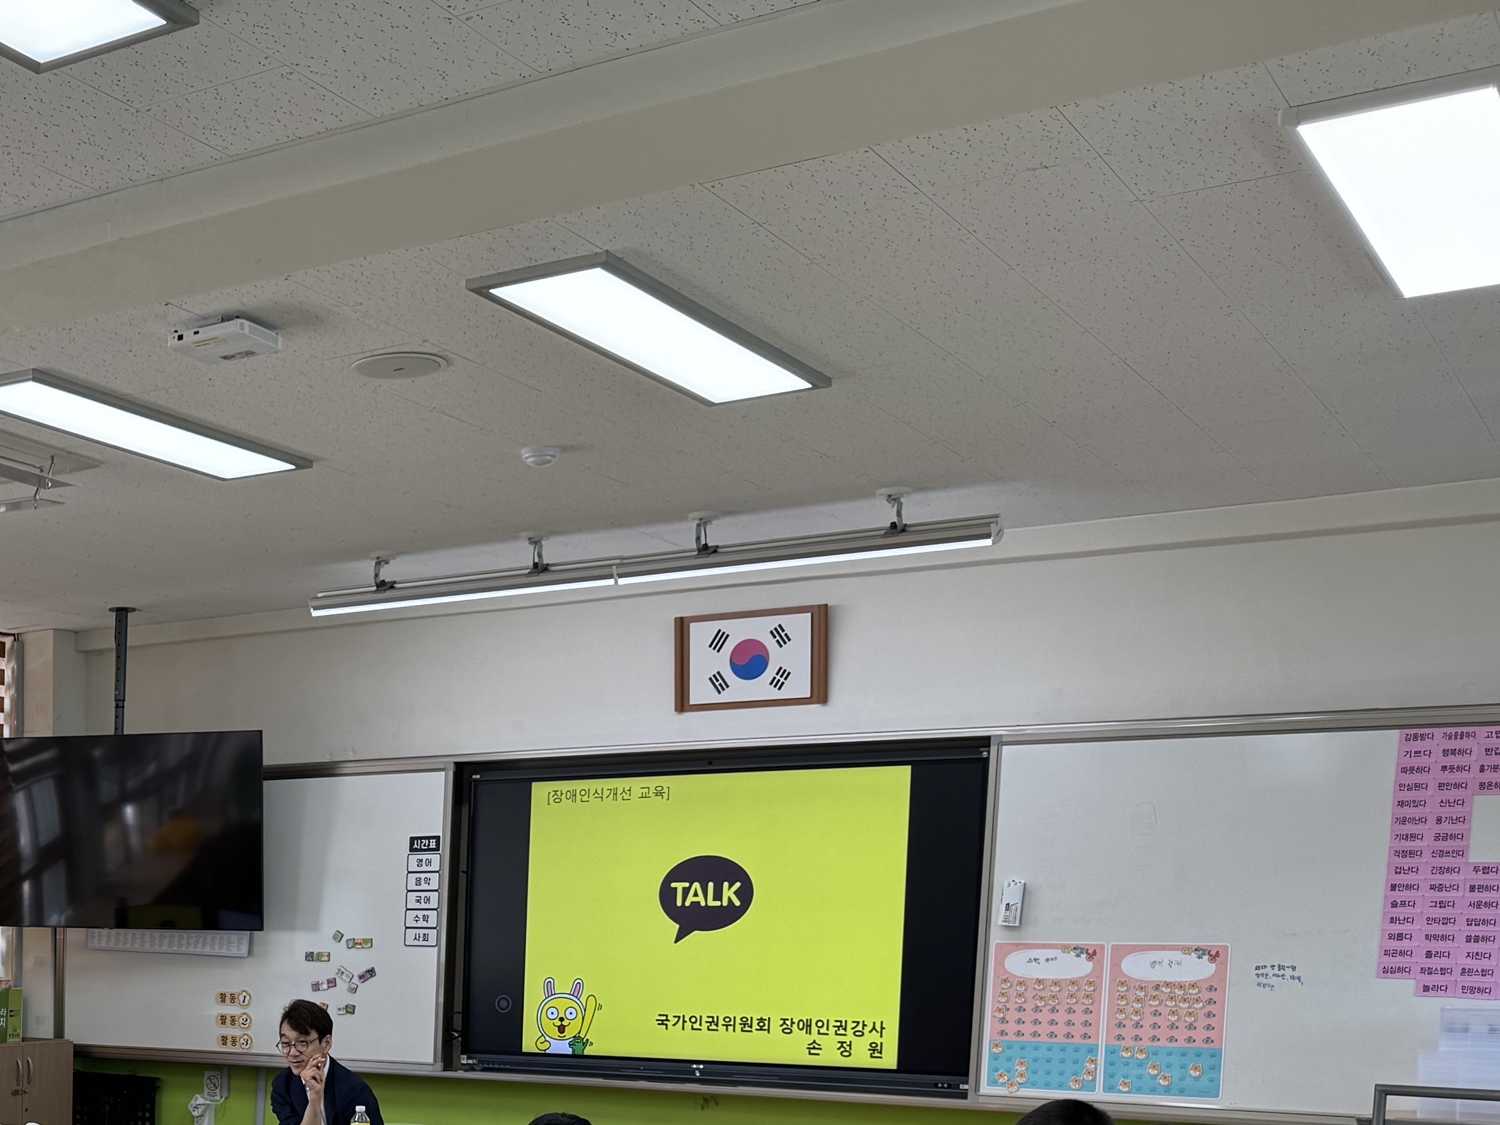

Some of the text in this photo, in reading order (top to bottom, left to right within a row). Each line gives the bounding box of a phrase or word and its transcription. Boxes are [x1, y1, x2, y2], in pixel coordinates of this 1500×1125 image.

[1404, 750, 1431, 758] 기쁘다
[1442, 748, 1472, 757] 행복하다
[1401, 766, 1430, 774] 따뜻하다
[1440, 764, 1471, 773] 뿌듯하다
[1479, 764, 1500, 773] 홀가분
[1399, 783, 1428, 791] 안심된다
[1438, 782, 1467, 790] 편안하다
[1397, 800, 1426, 808] 재미있다
[1439, 799, 1465, 807] 신난다
[1395, 816, 1427, 825] 기운이난다
[1436, 816, 1466, 825] 용기난다
[1394, 833, 1424, 841] 기대된다
[1434, 833, 1464, 841] 궁금하다
[412, 838, 437, 850] 시간표
[1394, 850, 1422, 858] 걱정된다
[1431, 849, 1464, 858] 신경쓰인다
[416, 857, 432, 868] 영어
[1395, 866, 1419, 874] 겁난다
[1431, 866, 1460, 875] 긴장하다
[1473, 866, 1499, 874] 두렵다
[414, 876, 431, 887] 음악
[1390, 883, 1419, 891] 불안하다
[1429, 884, 1459, 892] 짜증난다
[1469, 884, 1499, 892] 불편하다
[670, 880, 742, 908] TALK
[414, 895, 431, 905] 국어
[1391, 900, 1416, 908] 슬프다
[1429, 900, 1455, 908] 그립다
[1468, 901, 1498, 909] 서운하다
[413, 913, 429, 923] 수학
[1389, 916, 1414, 925] 화난다
[1426, 917, 1456, 925] 안타깝다
[1466, 918, 1496, 926] 답답하다
[413, 932, 429, 942] 사회
[1388, 933, 1412, 941] 외롭다
[1425, 934, 1455, 942] 막막하다
[1466, 935, 1495, 943] 쓸쓸하다
[1384, 949, 1413, 957] 피곤하다
[1465, 952, 1491, 960] 지친다
[1382, 966, 1411, 974] 심심하다
[1423, 984, 1448, 992] 놀라다
[1462, 986, 1491, 995] 민망하다
[219, 992, 247, 1004] 활동 1
[219, 1014, 248, 1026] 활동 2
[655, 1013, 886, 1039] 국가인권위원회 장애인권강사
[220, 1035, 249, 1047] 활동 3
[806, 1040, 885, 1059] 손 정 원
